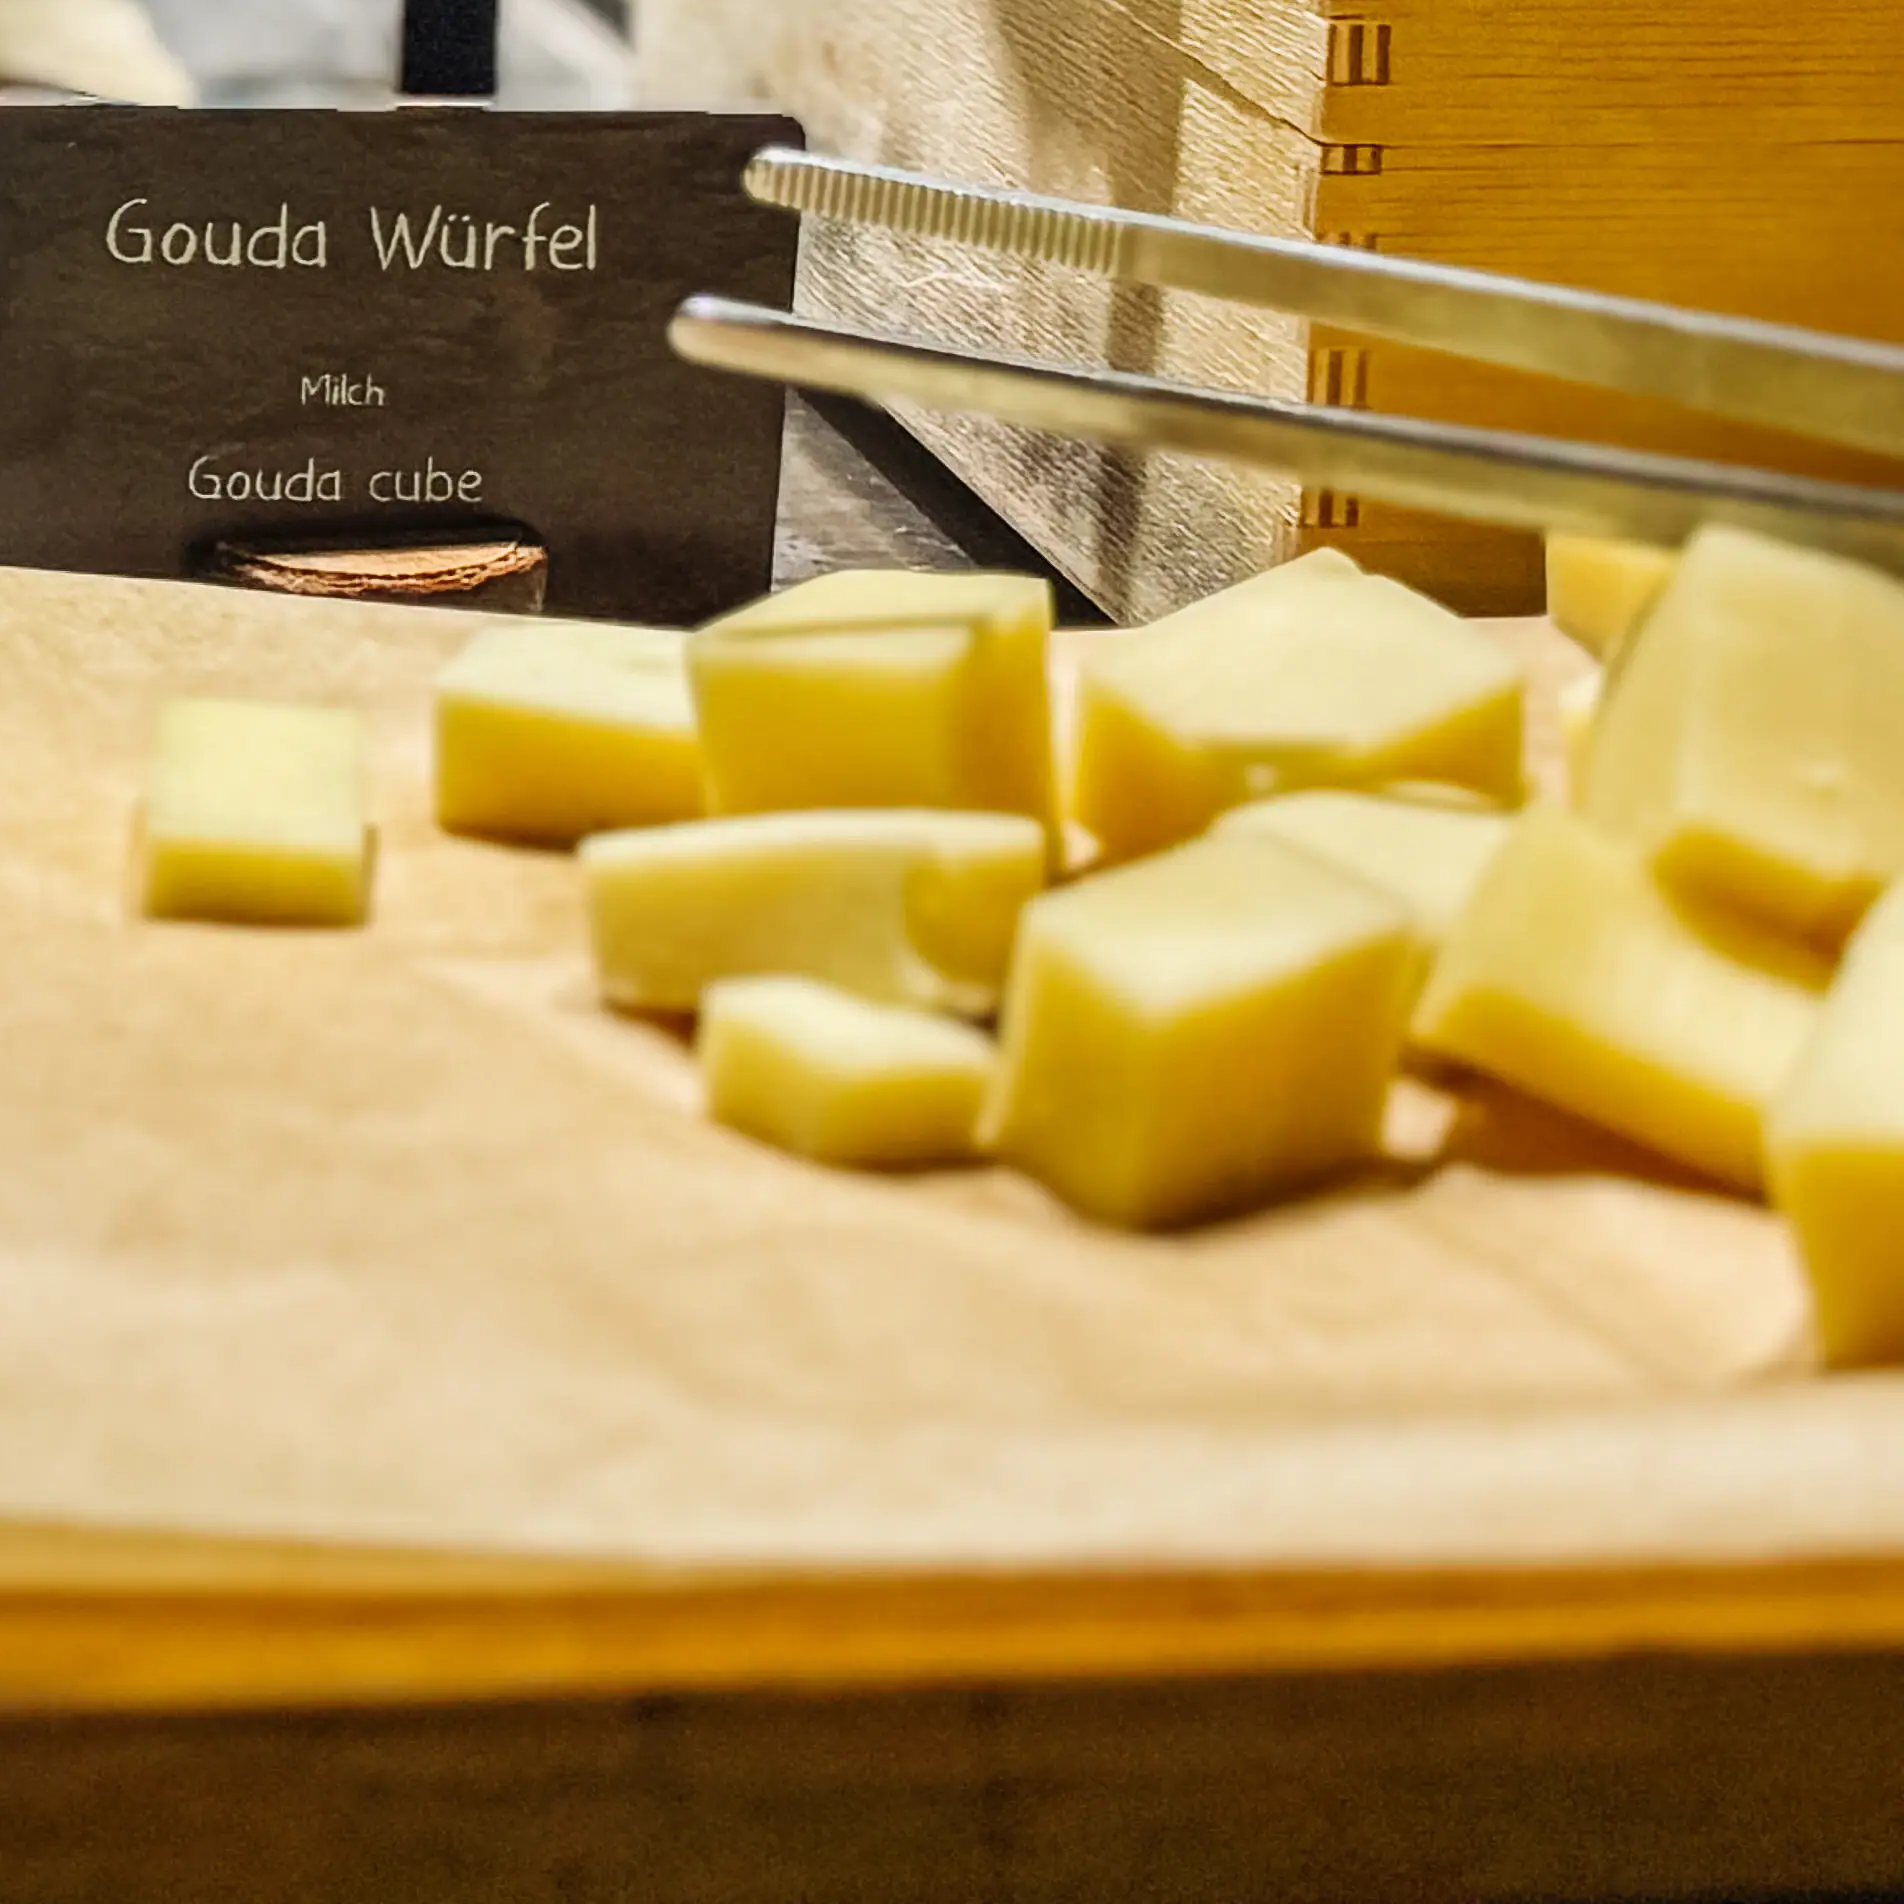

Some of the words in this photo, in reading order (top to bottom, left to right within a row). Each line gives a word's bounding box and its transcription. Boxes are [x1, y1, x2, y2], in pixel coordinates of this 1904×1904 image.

[106, 198, 328, 270] Gouda
[370, 201, 598, 272] Würfel
[301, 373, 386, 408] Milch
[188, 456, 343, 503] Gouda
[369, 456, 484, 503] cube
